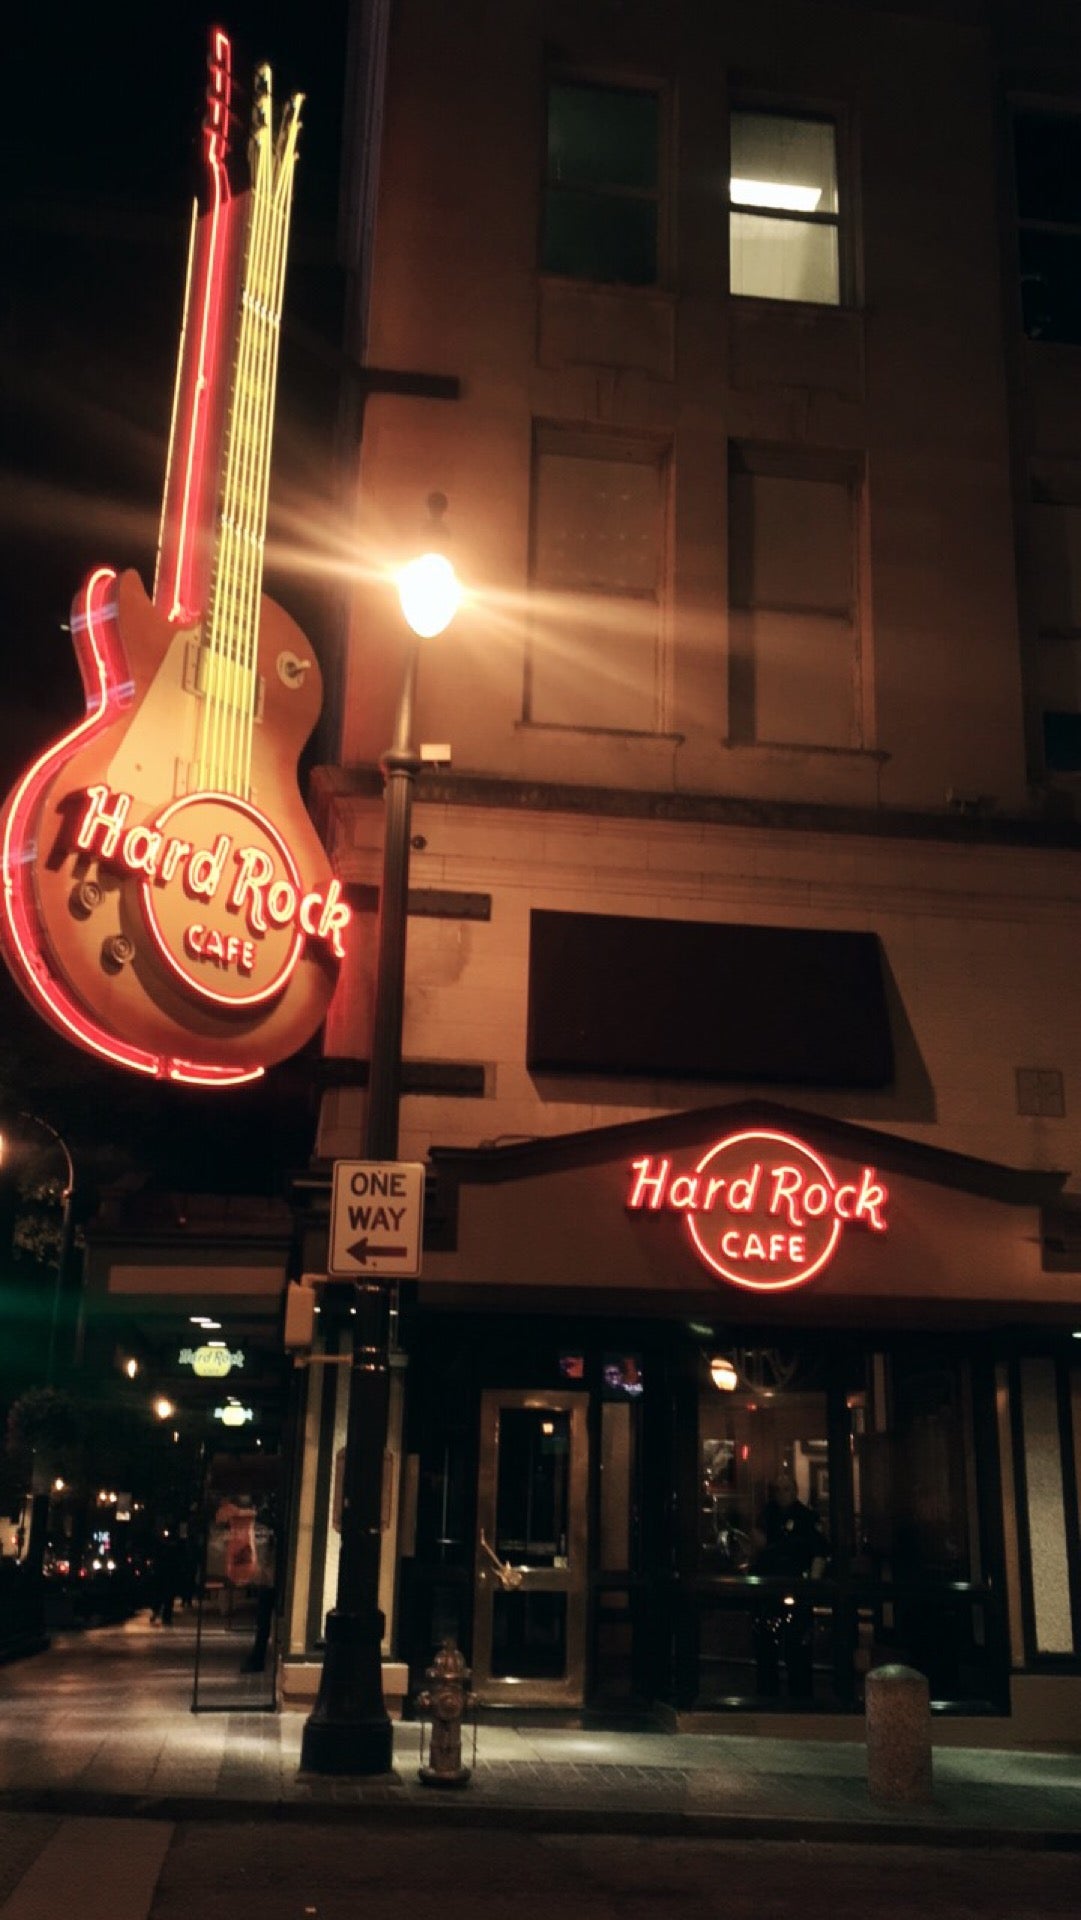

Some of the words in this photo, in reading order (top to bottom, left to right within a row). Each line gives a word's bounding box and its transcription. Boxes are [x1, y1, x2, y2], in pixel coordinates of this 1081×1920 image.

[76, 785, 231, 897] Hard
[232, 846, 351, 958] Rock
[187, 924, 256, 969] CAFE
[350, 1172, 407, 1197] ONE
[628, 1157, 761, 1211] Hard
[769, 1165, 886, 1231] Rock
[348, 1206, 406, 1231] WAY
[721, 1231, 806, 1262] CAFE
